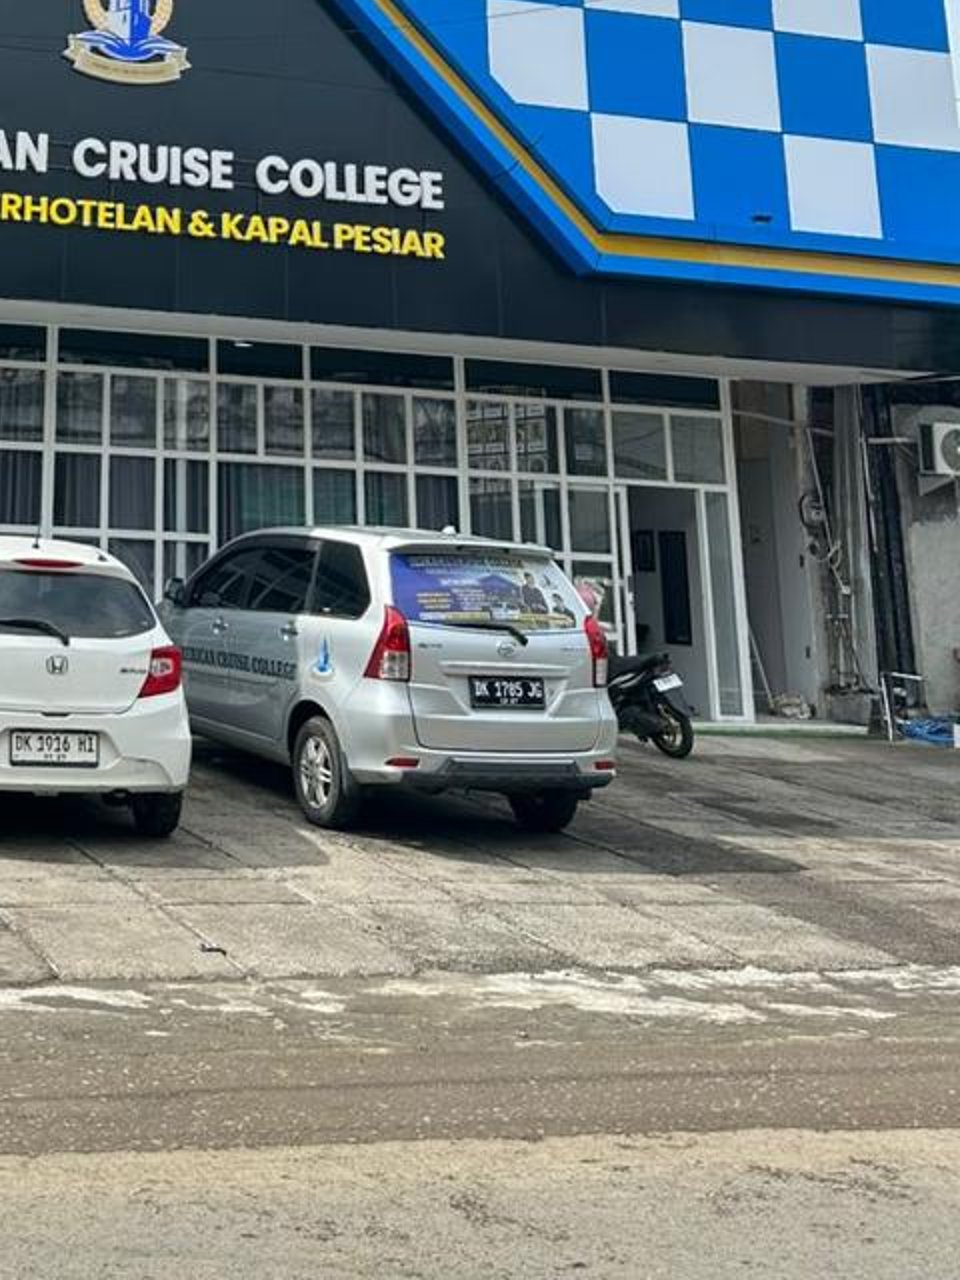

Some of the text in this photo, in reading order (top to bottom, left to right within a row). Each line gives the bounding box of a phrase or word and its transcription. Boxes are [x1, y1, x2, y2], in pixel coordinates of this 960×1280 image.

[73, 138, 234, 189] CRUISE
[255, 156, 445, 209] COLLEGE
[188, 213, 216, 237] &
[221, 214, 325, 249] KAPAL
[333, 225, 445, 258] PESIAR
[15, 735, 33, 751] DK
